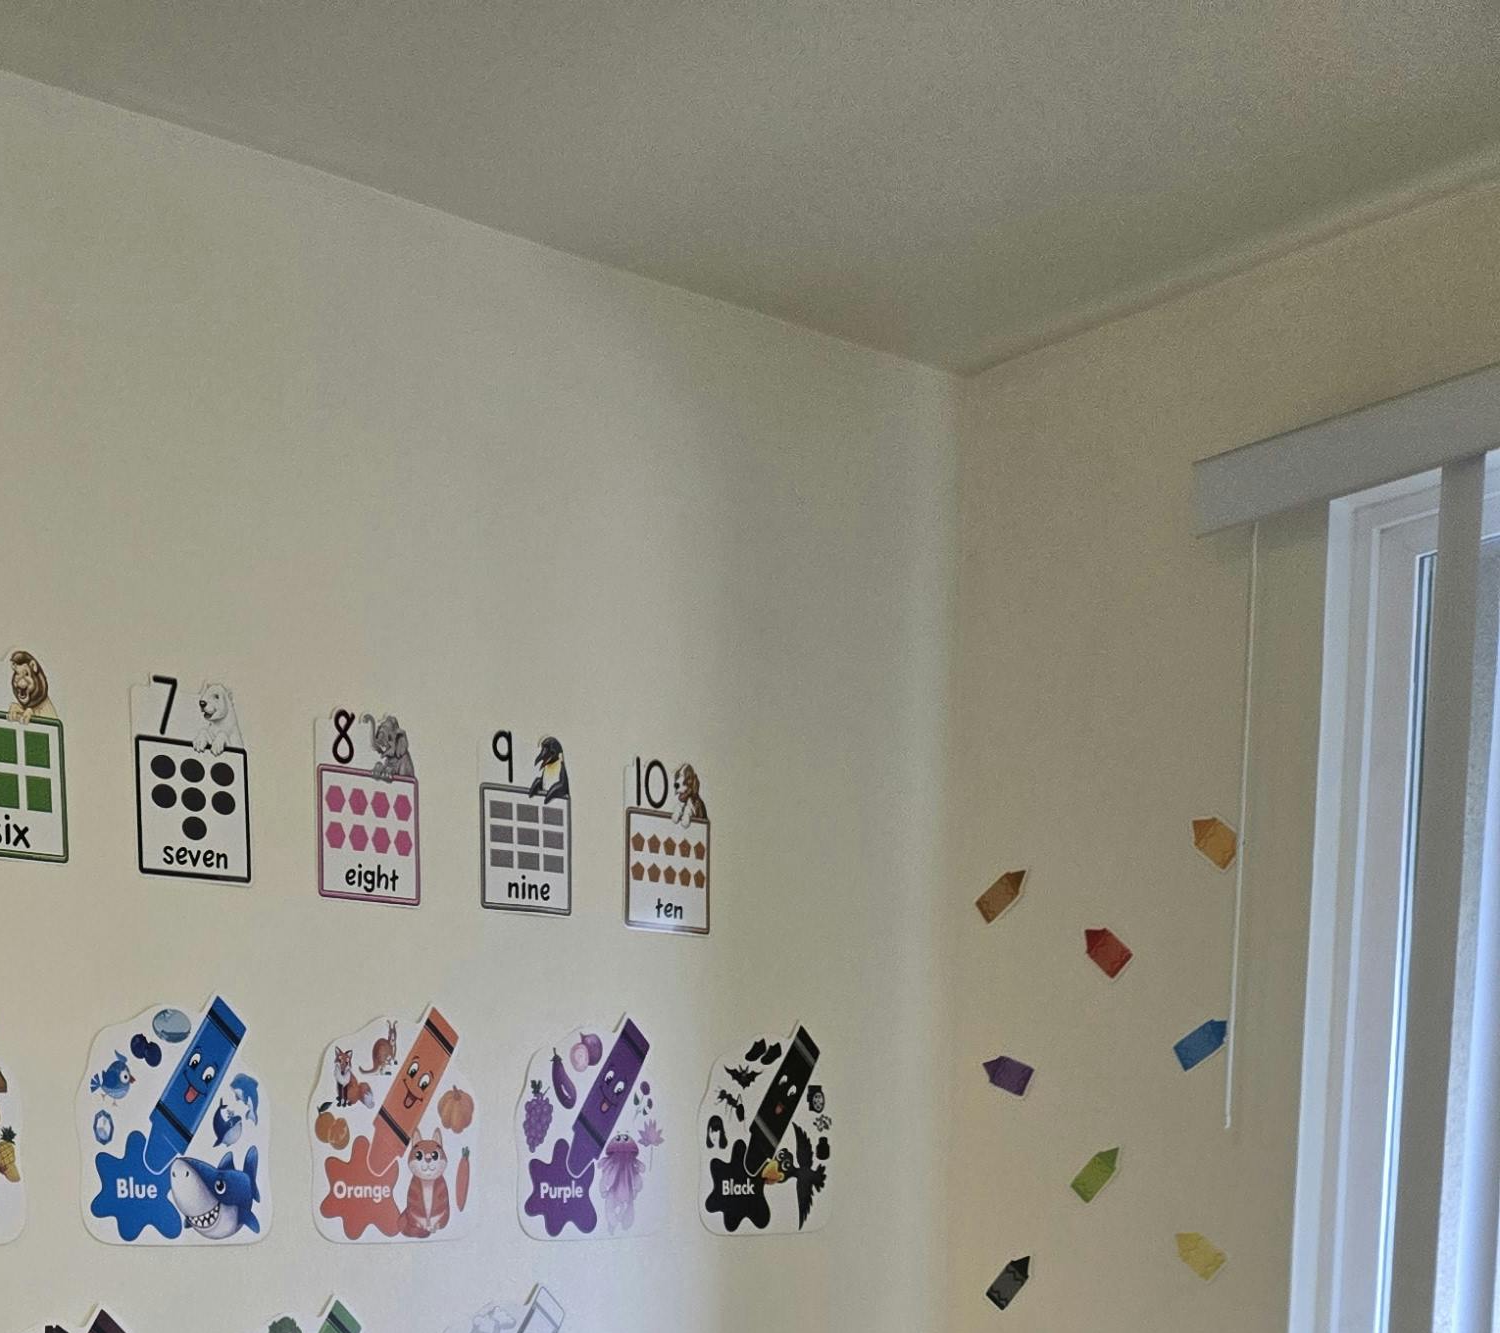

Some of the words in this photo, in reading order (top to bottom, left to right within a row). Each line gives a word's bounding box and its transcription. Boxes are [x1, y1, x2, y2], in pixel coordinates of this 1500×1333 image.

[153, 675, 177, 735] 7
[332, 709, 356, 765] 8
[492, 730, 514, 784] 9
[635, 757, 668, 809] 10
[162, 845, 229, 870] seven
[344, 863, 400, 893] eight
[507, 874, 551, 902] nine
[655, 898, 684, 920] ten
[116, 1178, 158, 1200] Blue
[333, 1179, 392, 1202] Orange
[539, 1180, 584, 1203] Purple
[721, 1177, 756, 1197] Black
